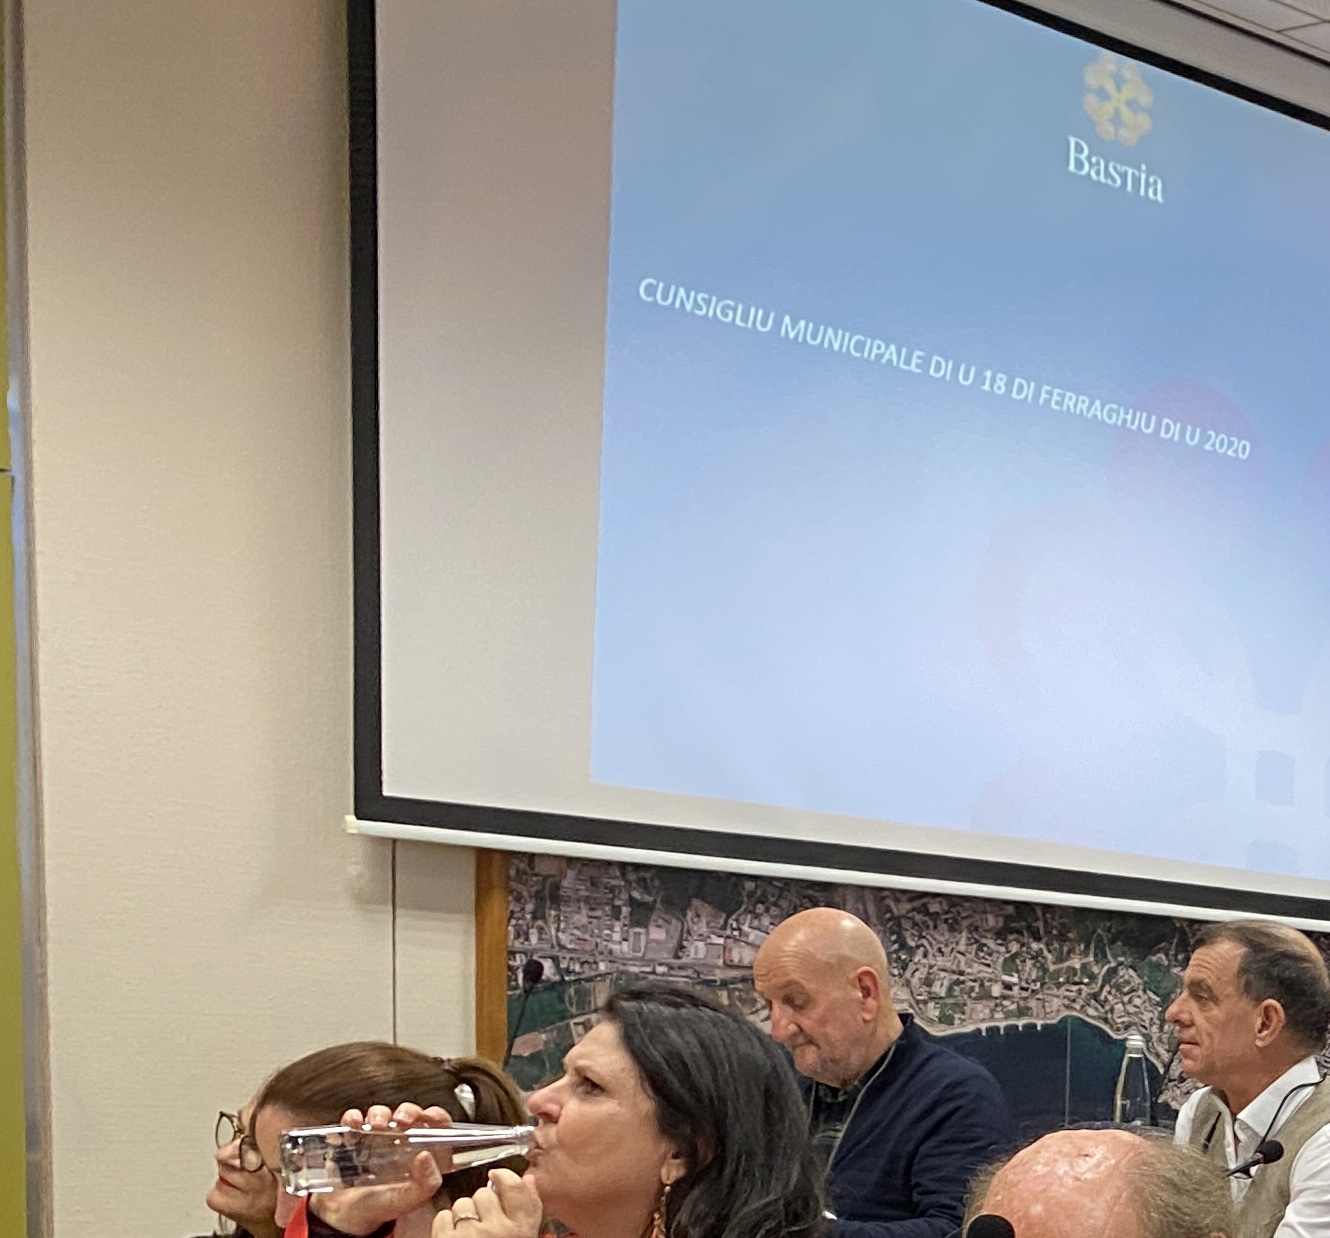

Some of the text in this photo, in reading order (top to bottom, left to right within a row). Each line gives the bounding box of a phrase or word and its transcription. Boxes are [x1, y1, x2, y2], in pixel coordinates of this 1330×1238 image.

[638, 278, 1251, 461] CUNSIGLIU MUNICIPALE DI U 18 DI FERRAGHJU DI U 2020
